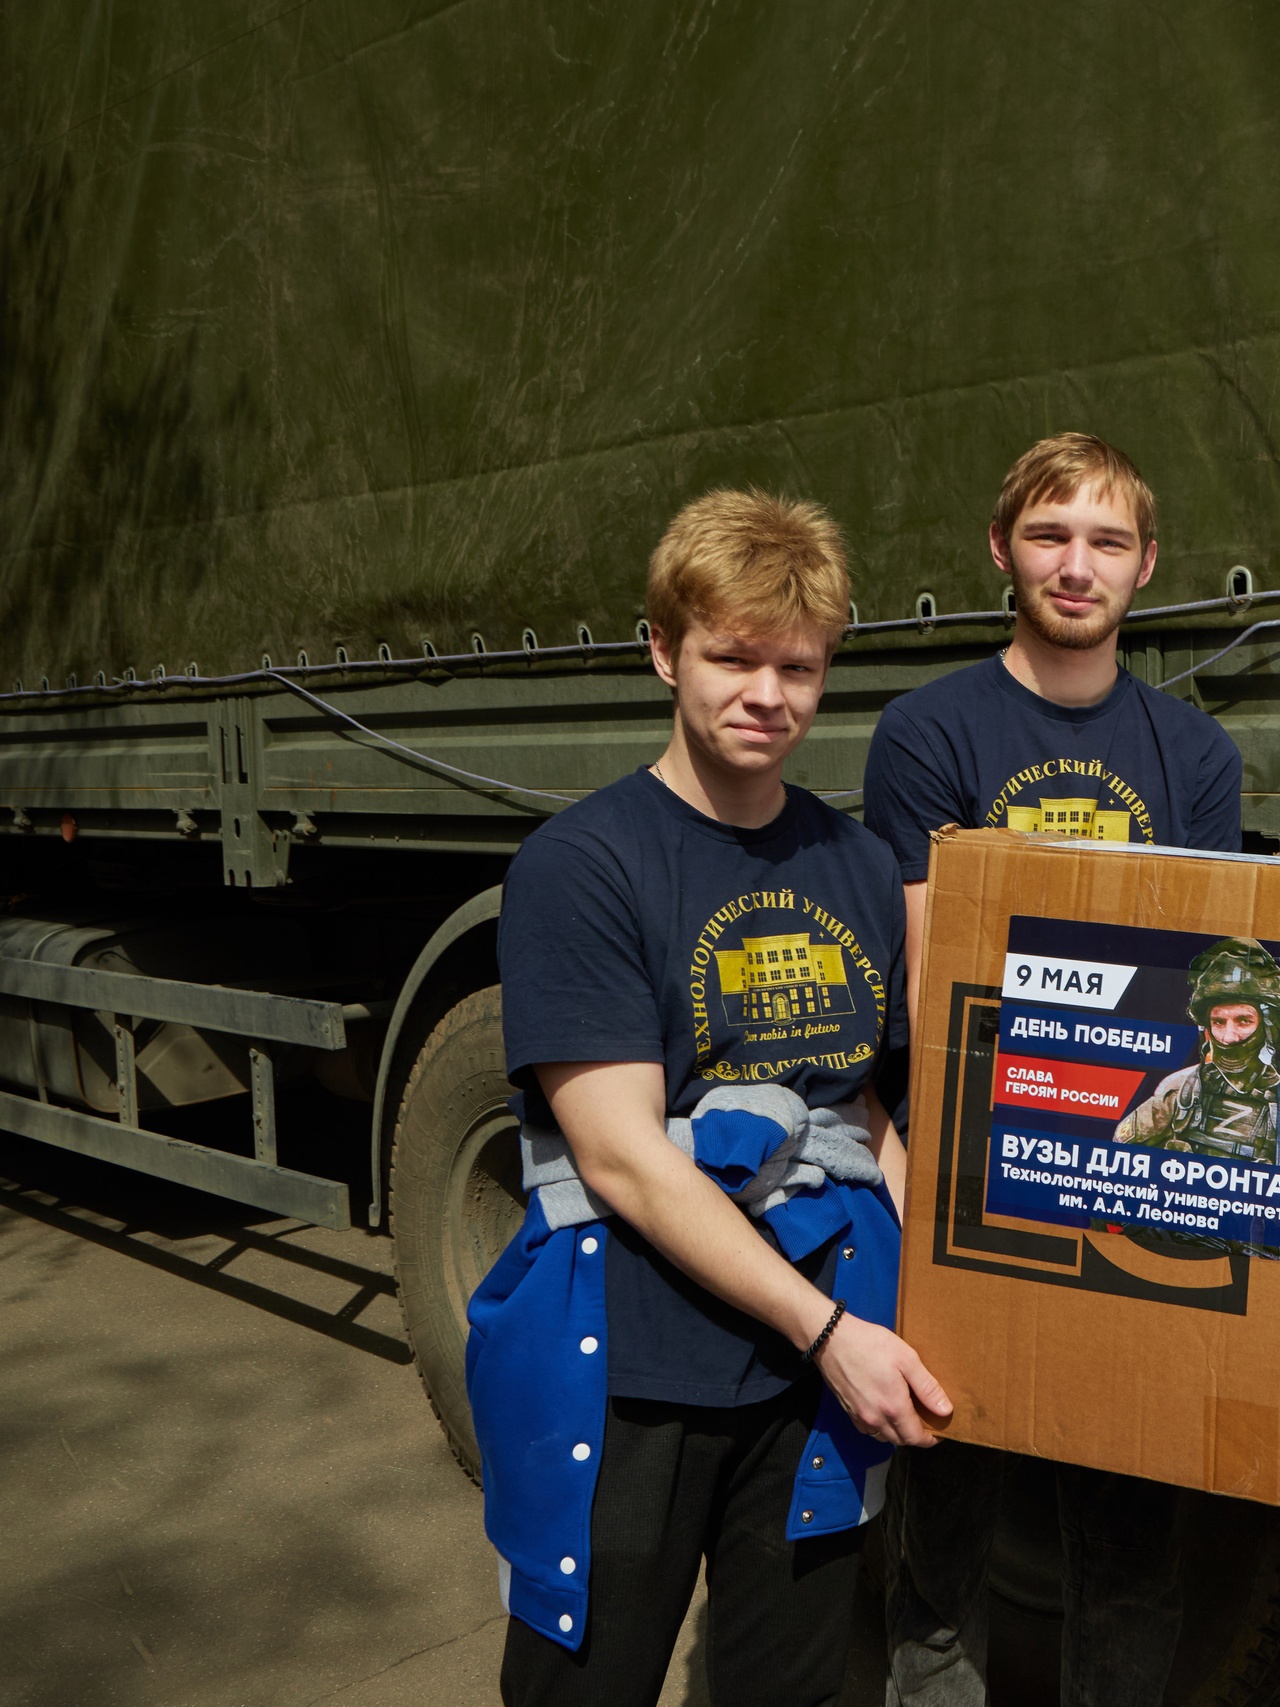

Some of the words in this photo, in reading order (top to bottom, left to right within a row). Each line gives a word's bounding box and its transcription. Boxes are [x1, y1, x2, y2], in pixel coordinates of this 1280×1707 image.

[983, 758, 1103, 829] ЛОГИЧЕСКИЙ
[1016, 964, 1032, 986] 9
[1041, 967, 1103, 995] МАЯ
[790, 1025, 802, 1038] in
[804, 1023, 840, 1039] futuro
[1010, 1016, 1068, 1040] ДЕНЬ
[1074, 1024, 1172, 1054] ПОБЕДЫ
[1005, 1081, 1058, 1099] ГЕРОЯМ
[1060, 1088, 1119, 1107] РОССИИ
[1007, 1067, 1054, 1084] СЛАВА
[1002, 1134, 1080, 1168] ВУЗЫ
[1086, 1147, 1151, 1178] ДЛЯ
[1001, 1162, 1159, 1202] Технологический
[1059, 1193, 1088, 1210] им.
[1093, 1197, 1131, 1217] А.А.
[1137, 1203, 1219, 1231] Леонова
